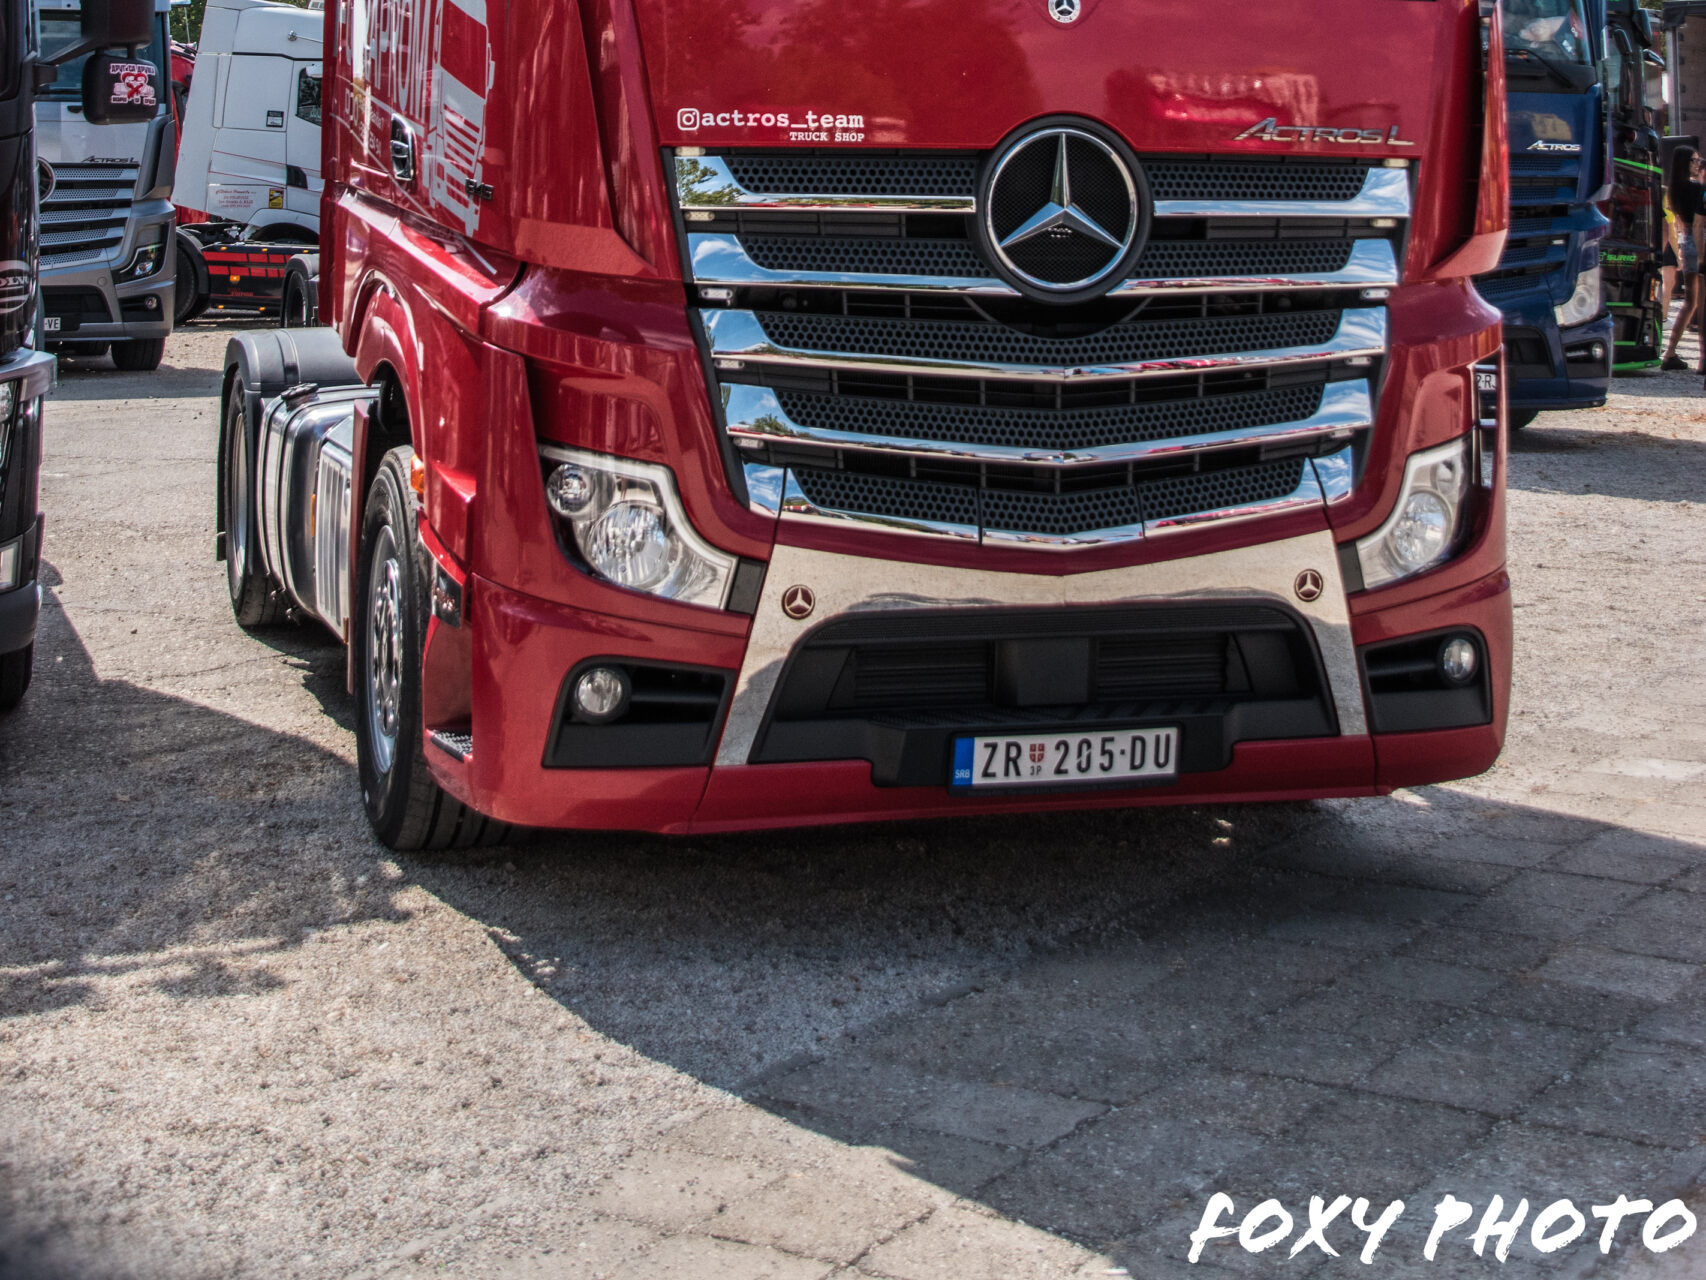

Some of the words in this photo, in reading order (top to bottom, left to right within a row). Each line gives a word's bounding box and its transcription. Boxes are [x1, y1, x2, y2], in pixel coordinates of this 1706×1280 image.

[701, 110, 865, 128] actros_team
[789, 132, 828, 141] TRUCK
[834, 132, 865, 142] SHOP
[1387, 125, 1414, 146] L
[981, 740, 1022, 778] ZR
[955, 768, 971, 779] SRB
